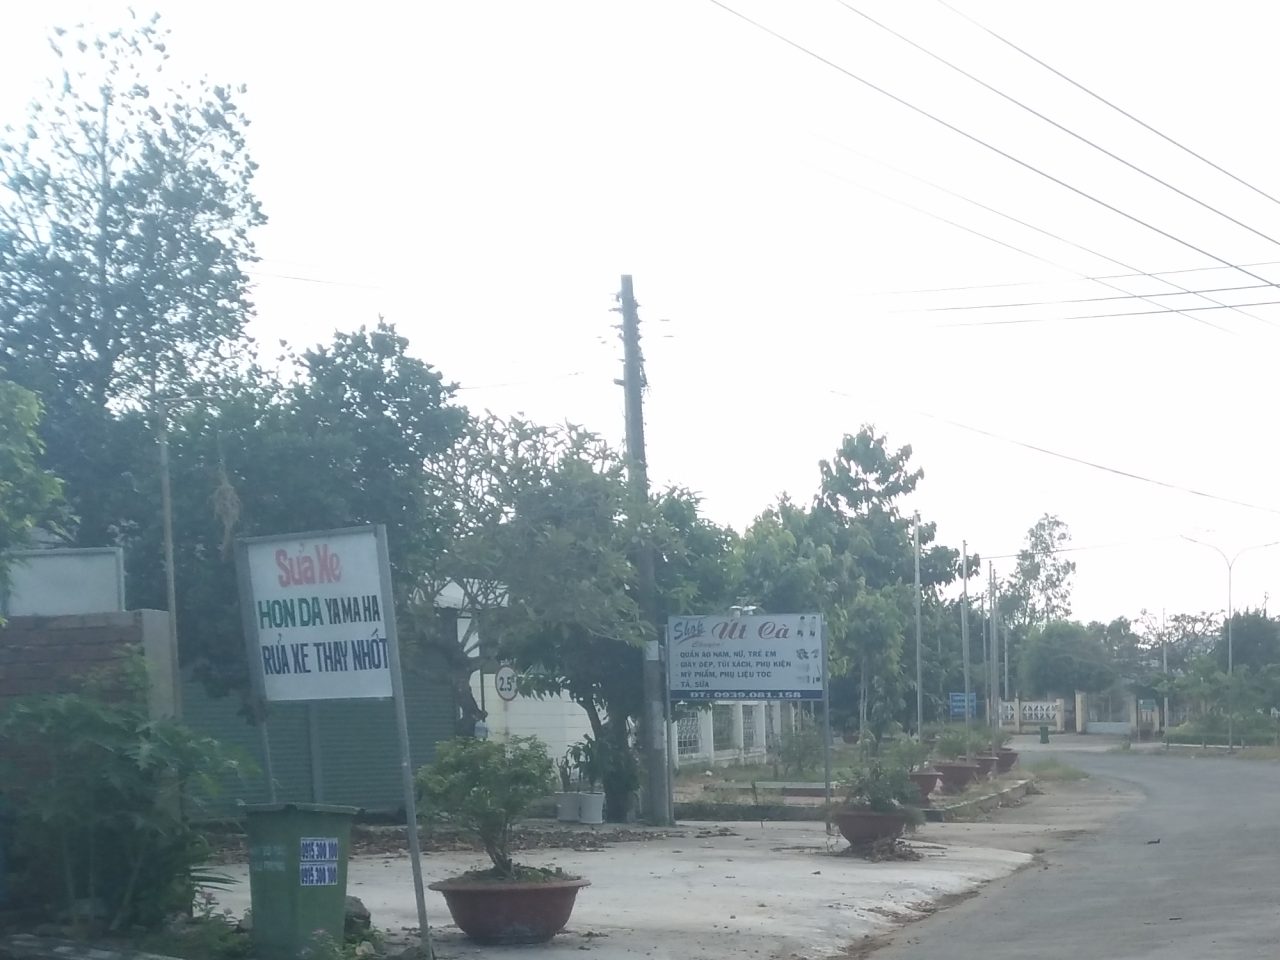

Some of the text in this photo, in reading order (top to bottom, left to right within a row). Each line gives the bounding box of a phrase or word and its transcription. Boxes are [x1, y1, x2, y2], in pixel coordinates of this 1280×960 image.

[315, 544, 342, 584] Xe
[261, 628, 388, 675] RỬA XE THAY NHỚT
[765, 650, 777, 658] EM
